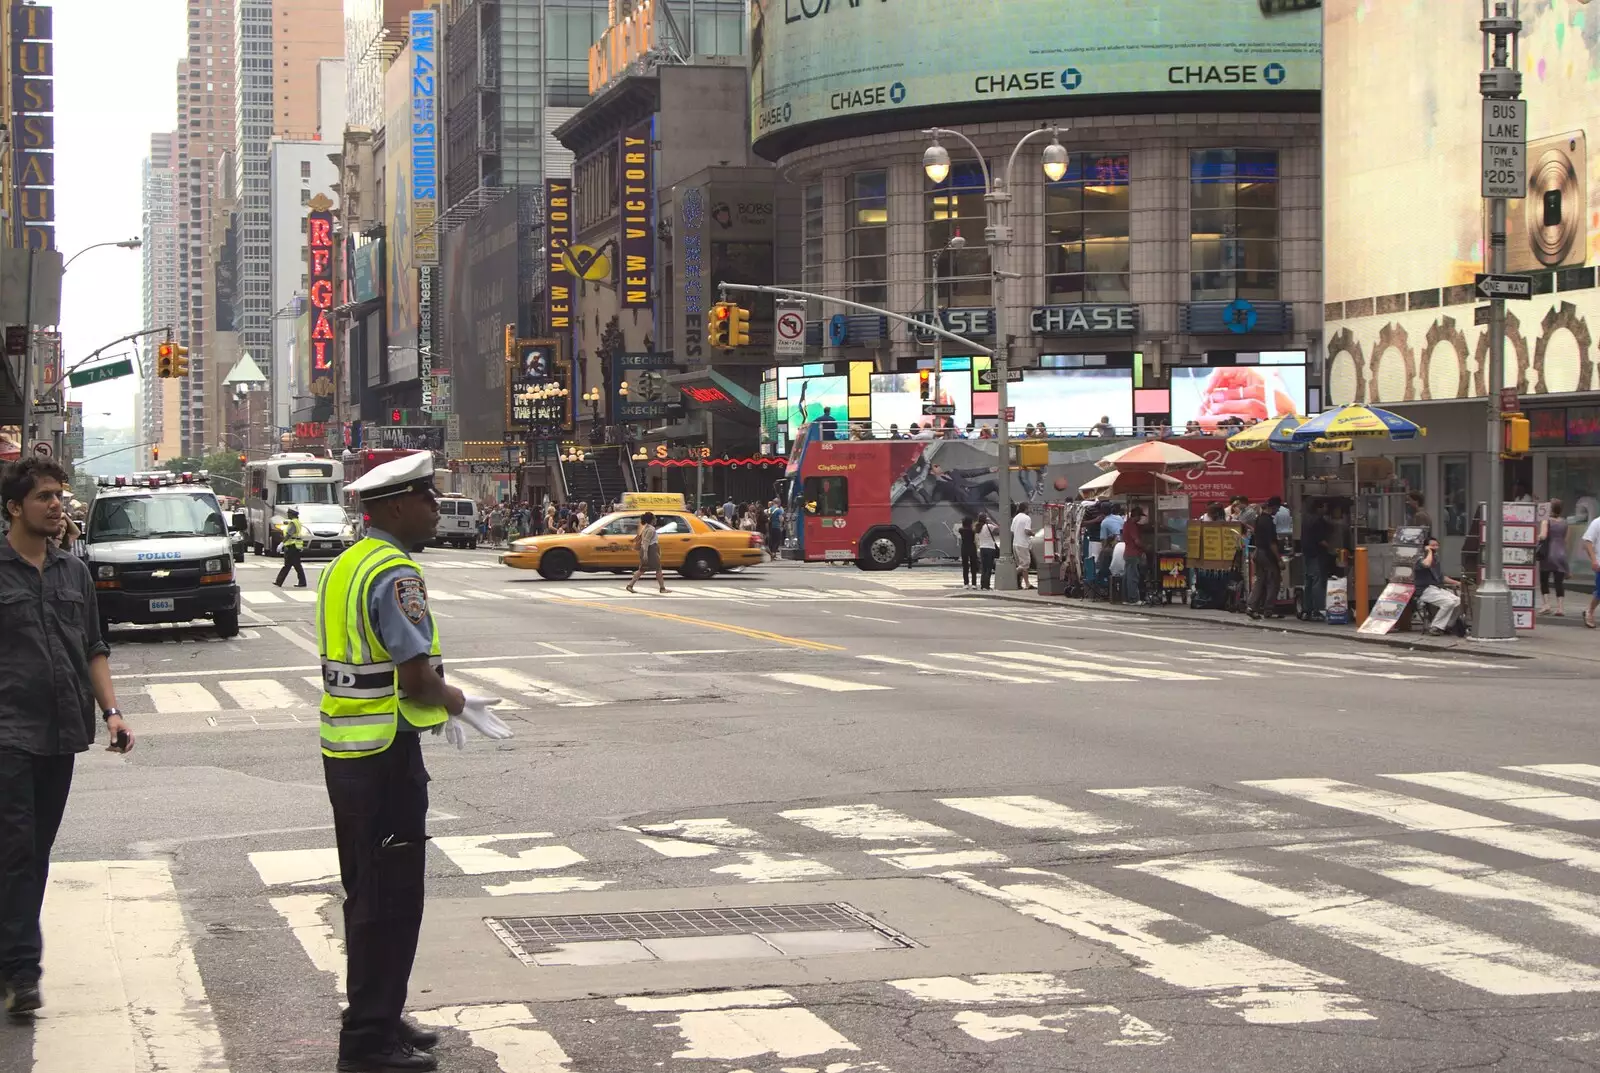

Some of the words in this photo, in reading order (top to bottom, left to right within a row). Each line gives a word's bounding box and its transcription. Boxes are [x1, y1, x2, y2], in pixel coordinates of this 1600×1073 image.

[412, 13, 434, 52] NEW
[975, 72, 1055, 93] CHASE
[1168, 66, 1257, 83] CHASE
[831, 87, 885, 110] CHASE
[759, 106, 782, 130] CHASE
[1492, 105, 1516, 118] BUS
[1488, 124, 1519, 137] LANE
[1489, 146, 1508, 155] TOW
[1512, 147, 1518, 155] &
[413, 124, 436, 199] STUDIOS
[1493, 158, 1513, 167] FINE
[625, 137, 646, 239] VICTORY
[738, 203, 773, 214] BOBS
[551, 184, 569, 272] VICTORY
[626, 255, 647, 302] NEW
[1483, 281, 1500, 291] ONE
[1508, 283, 1526, 293] WAY
[310, 219, 333, 369] REGAL
[551, 286, 569, 327] NEW
[1030, 308, 1135, 331] CHASE
[88, 371, 95, 380] 7
[384, 429, 403, 441] MAN
[137, 552, 182, 560] POLICE
